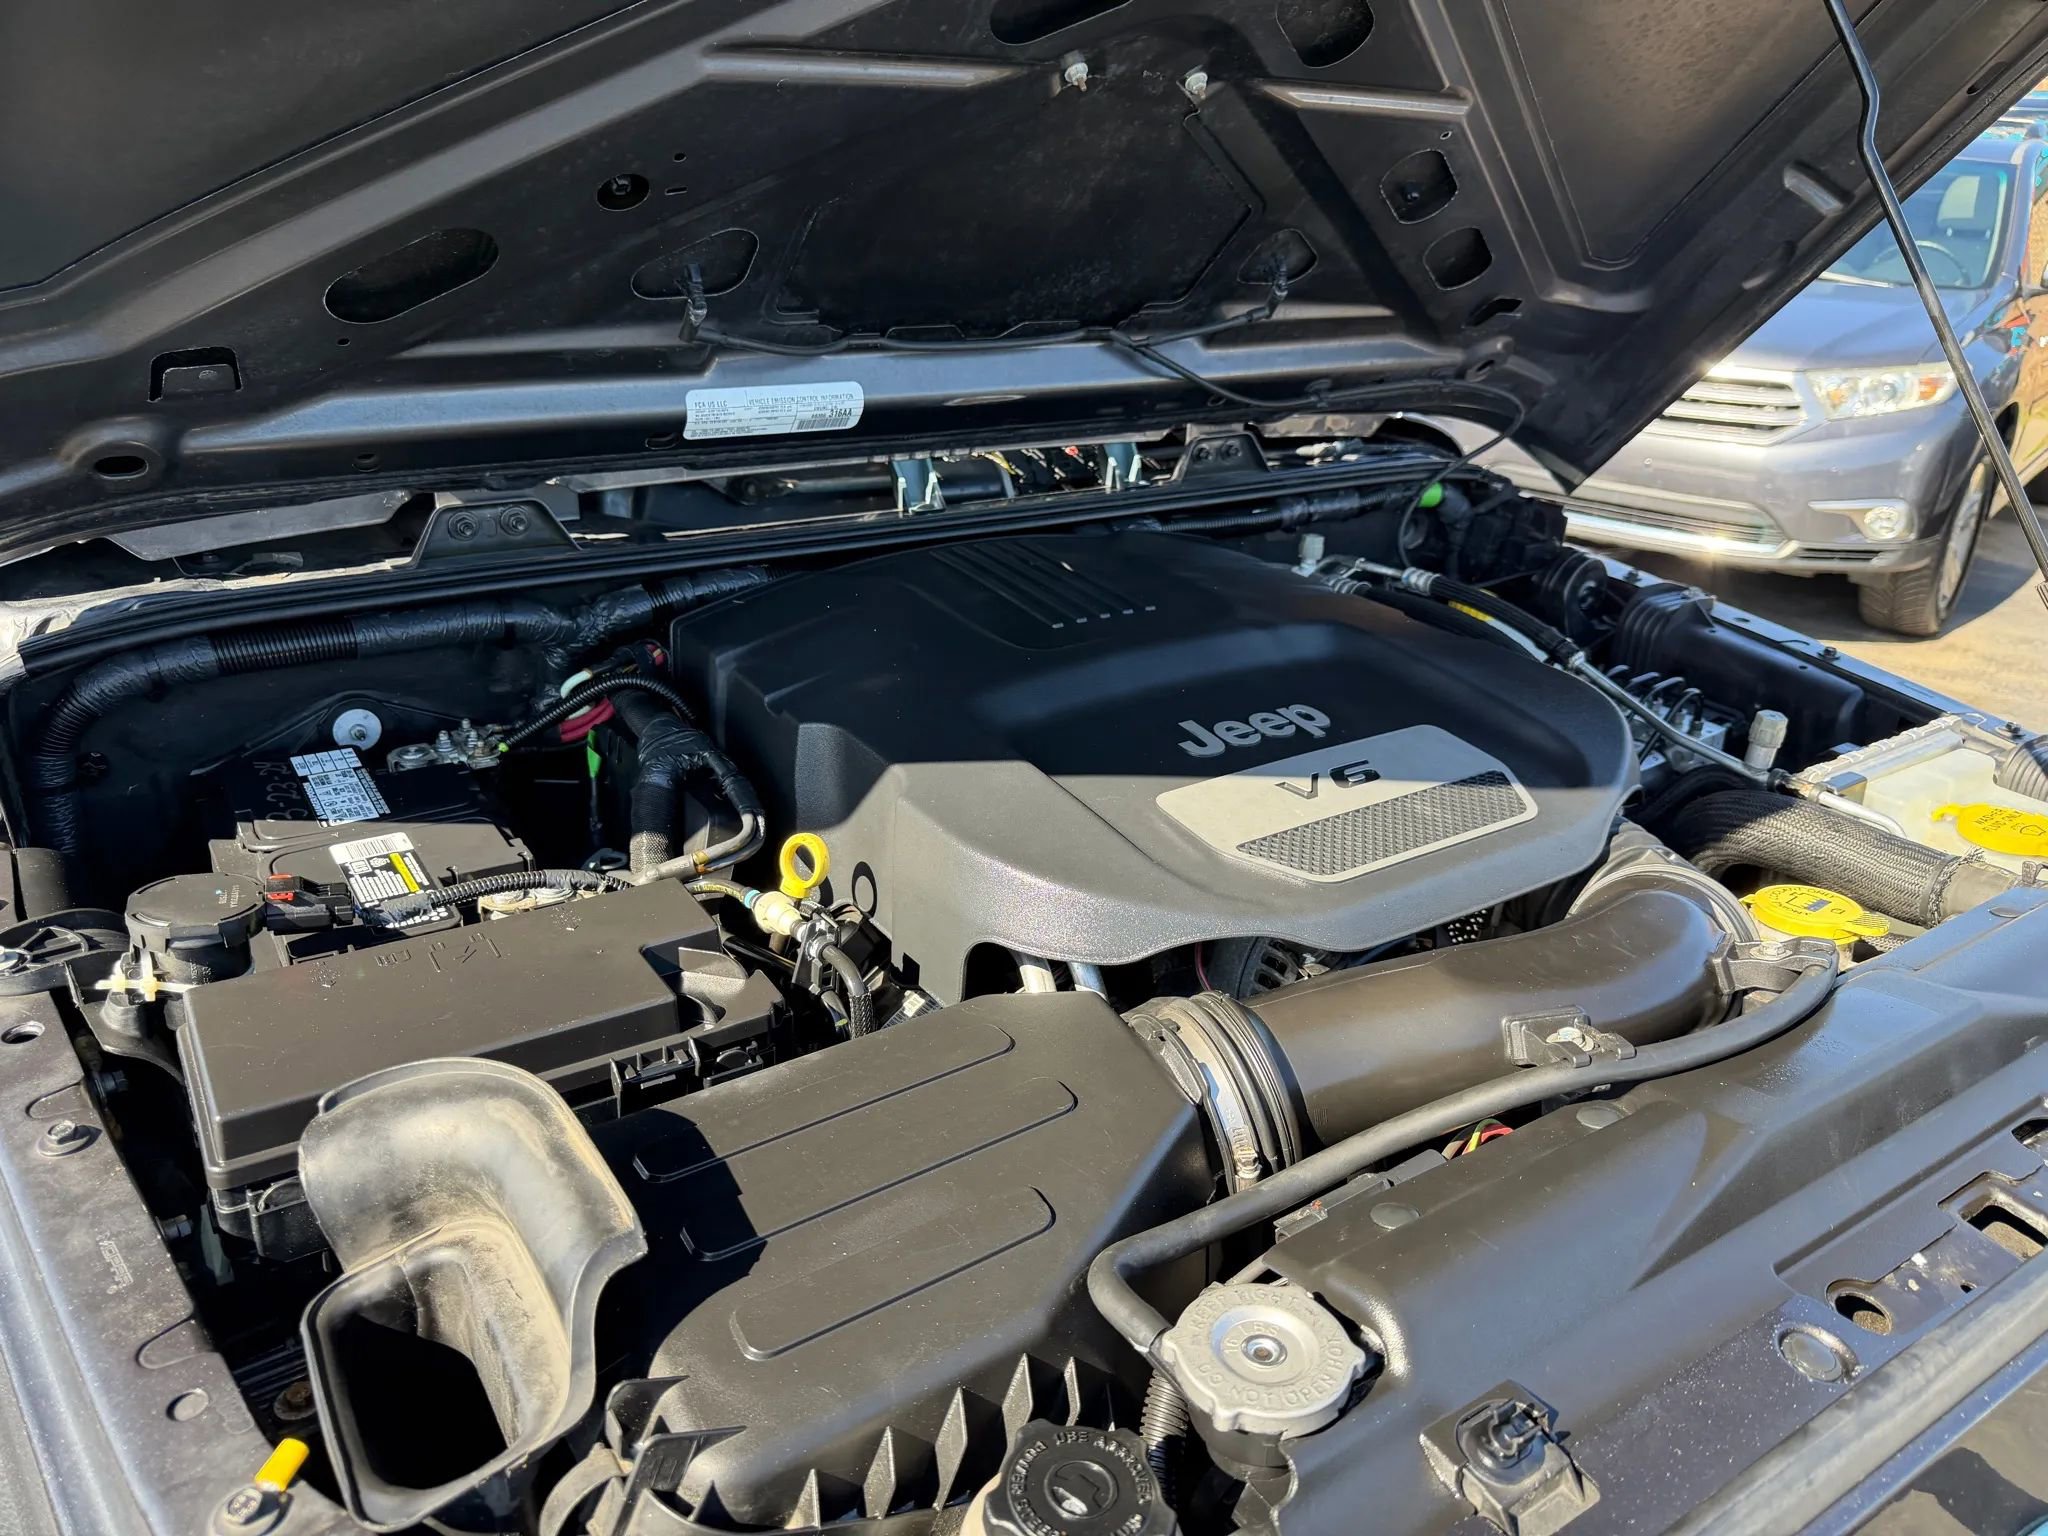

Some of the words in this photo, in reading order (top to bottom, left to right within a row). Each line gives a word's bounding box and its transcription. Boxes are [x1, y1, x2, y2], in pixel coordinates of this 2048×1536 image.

[748, 397, 770, 405] VEHICLE
[1178, 704, 1331, 758] Jeep
[1275, 759, 1381, 800] V6
[1222, 1336, 1242, 1354] 16
[1237, 1321, 1281, 1337] LBS
[1229, 1384, 1275, 1405] NOT
[1281, 1373, 1338, 1406] OPEN
[1325, 1329, 1347, 1373] HOT
